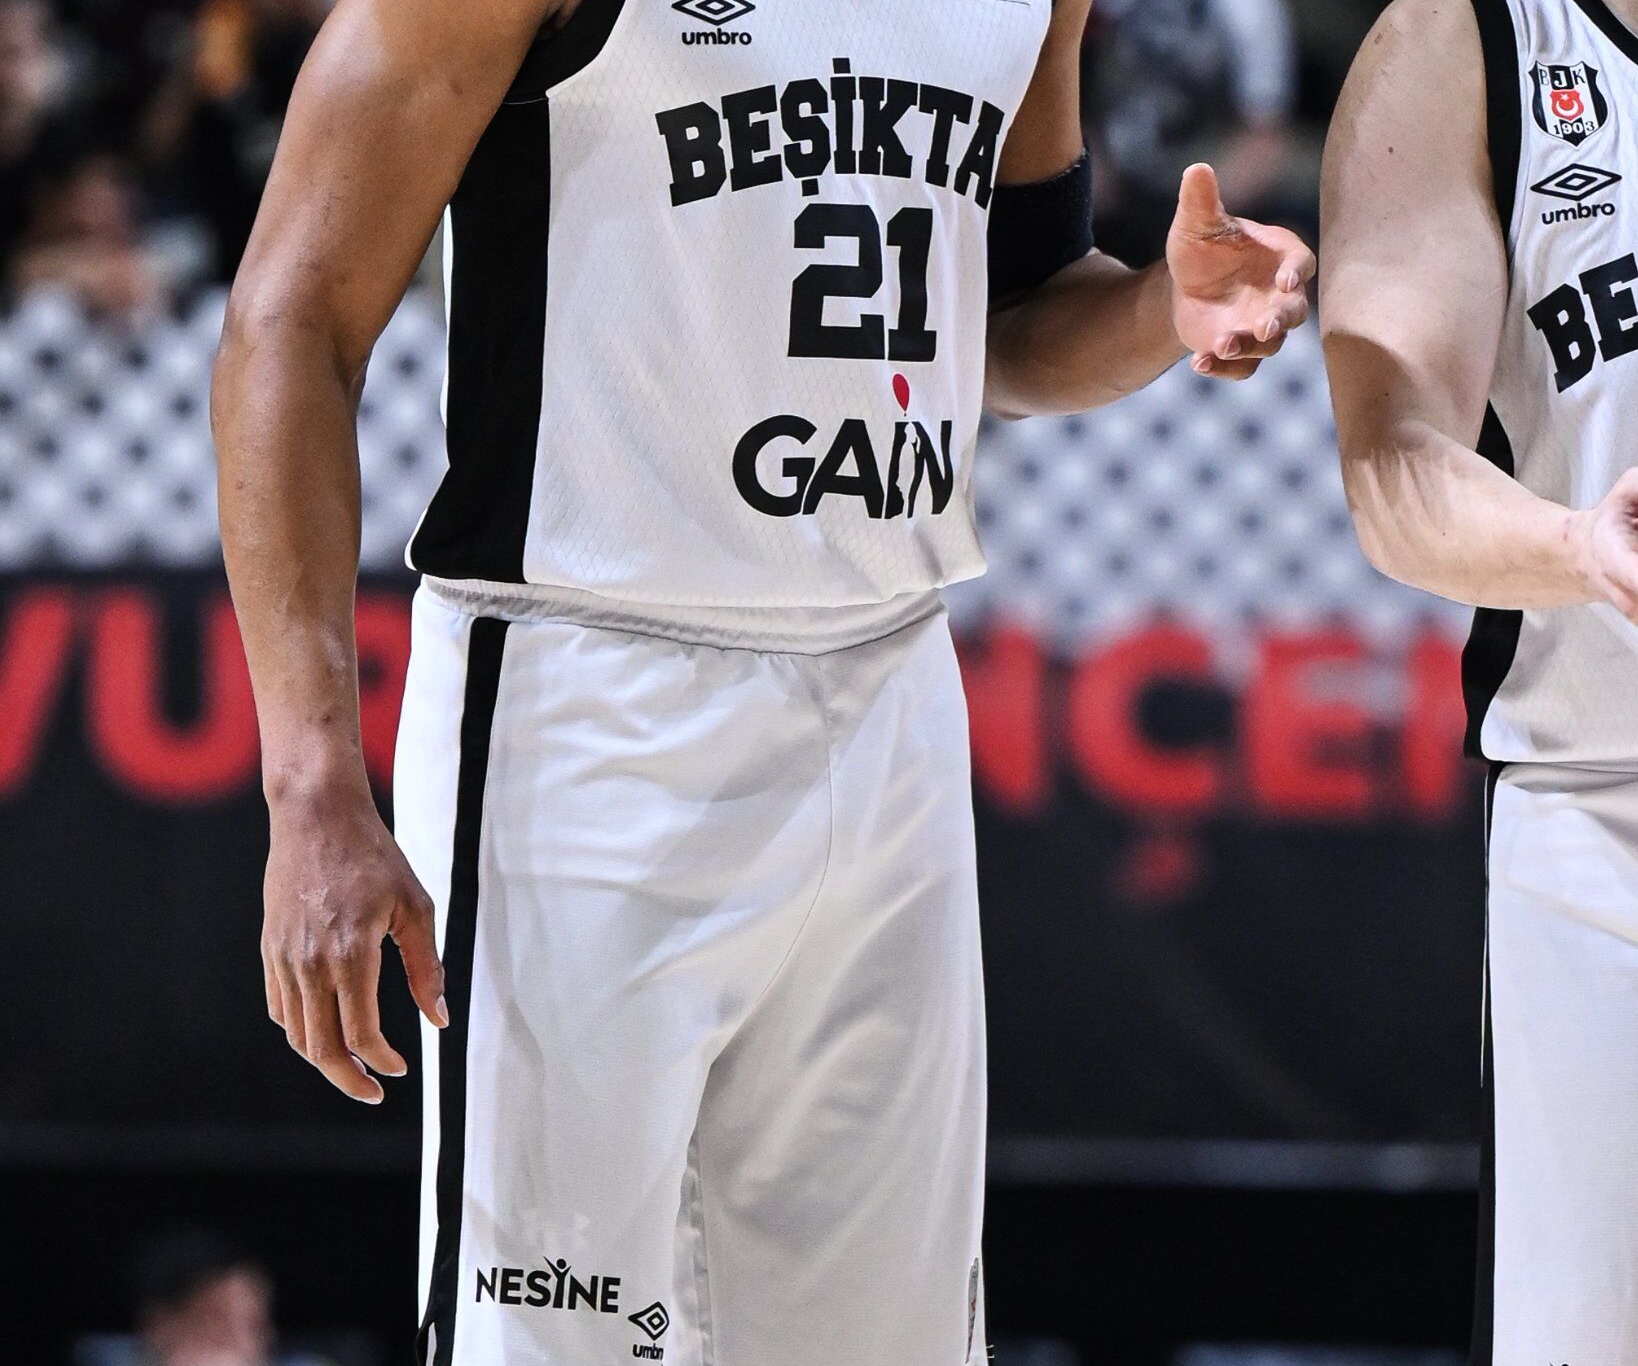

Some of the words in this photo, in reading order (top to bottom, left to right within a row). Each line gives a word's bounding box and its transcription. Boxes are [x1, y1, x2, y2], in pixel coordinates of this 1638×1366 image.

[681, 27, 753, 46] umbro
[1538, 69, 1587, 88] BJK
[656, 58, 1006, 207] BEŞİKTA
[1553, 120, 1596, 135] 1903
[1541, 201, 1616, 225] umbro
[787, 203, 937, 363] 21
